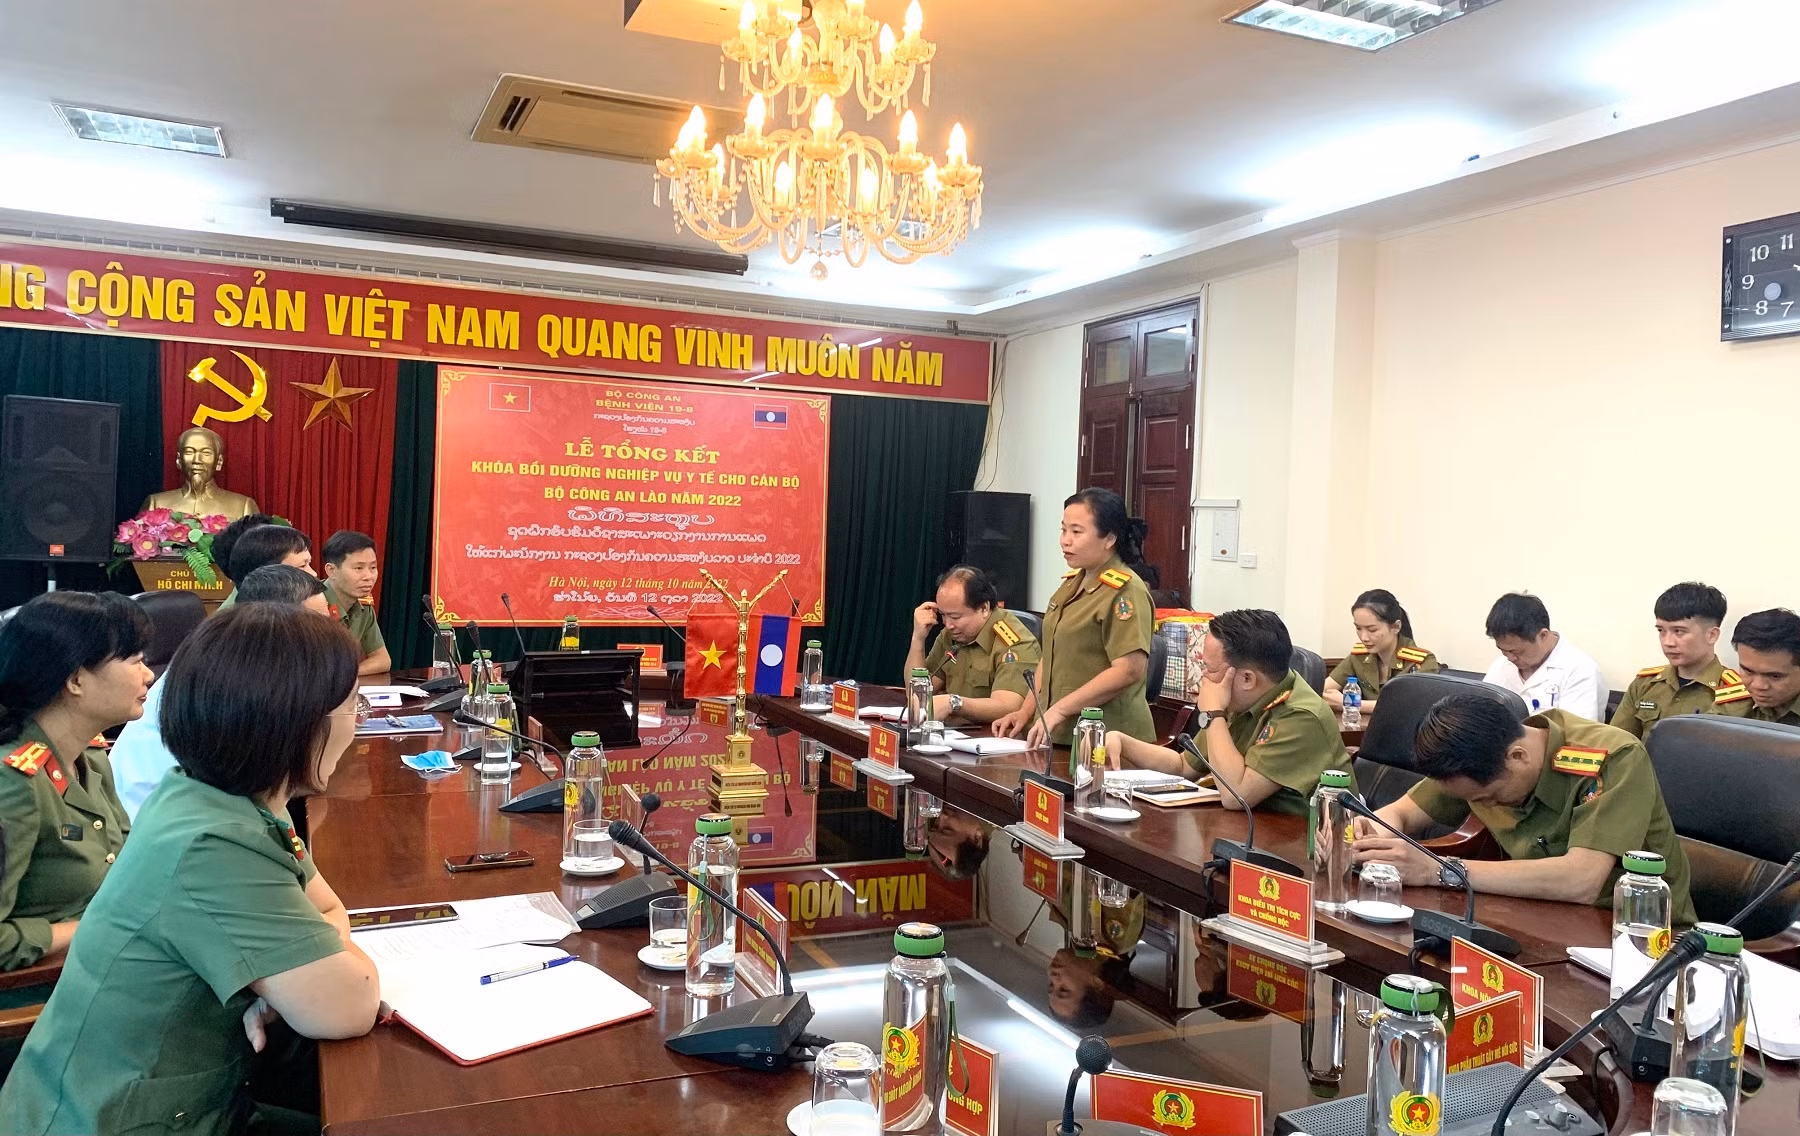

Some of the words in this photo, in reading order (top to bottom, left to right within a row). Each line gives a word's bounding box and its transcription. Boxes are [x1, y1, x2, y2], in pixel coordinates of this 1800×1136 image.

[1780, 233, 1794, 250] 11
[1749, 244, 1770, 262] 10
[1741, 274, 1755, 290] 9
[1755, 300, 1768, 316] 8
[1780, 300, 1795, 318] 7
[66, 261, 195, 328] CỘNG
[214, 270, 306, 332] SẢN
[324, 288, 410, 349] VIỆT
[427, 303, 520, 351] NAM
[537, 318, 662, 364] QUANG
[674, 327, 753, 372] VINH
[767, 332, 860, 380] MUÔN
[871, 340, 943, 387] NĂM
[605, 389, 623, 399] BỘ
[626, 389, 661, 400] CÔNG
[663, 393, 682, 402] AN
[595, 399, 631, 410] BỆNH
[634, 401, 664, 412] VIỆN
[669, 405, 694, 413] 19-8
[565, 436, 594, 457] LỄ
[600, 439, 668, 461] TỔNG
[674, 444, 721, 464] KẾT
[471, 460, 514, 474] KHÓA
[549, 463, 601, 479] DƯỠNG
[605, 467, 660, 484] NGHIỆP
[664, 471, 682, 485] VỤ
[686, 472, 695, 483] Y
[698, 469, 715, 484] TẾ
[718, 473, 747, 486] CHO
[750, 473, 778, 487] CÁN
[782, 475, 800, 490] BỘ
[544, 485, 565, 501] BỘ
[569, 487, 610, 501] CÔNG
[614, 490, 636, 503] AN
[639, 490, 667, 504] LÀO
[671, 491, 704, 505] NĂM
[708, 495, 742, 507] 2022
[774, 553, 801, 565] 2022
[549, 576, 566, 588] Hà
[567, 577, 590, 590] Nội,
[592, 579, 618, 591] ngày
[620, 578, 632, 588] 12
[634, 578, 664, 590] tháng
[667, 579, 679, 589] 10
[681, 580, 703, 589] năm
[641, 592, 658, 603] 12
[691, 593, 724, 603] 2022
[1461, 982, 1479, 1000] KHOA
[966, 1096, 984, 1116] HỢP
